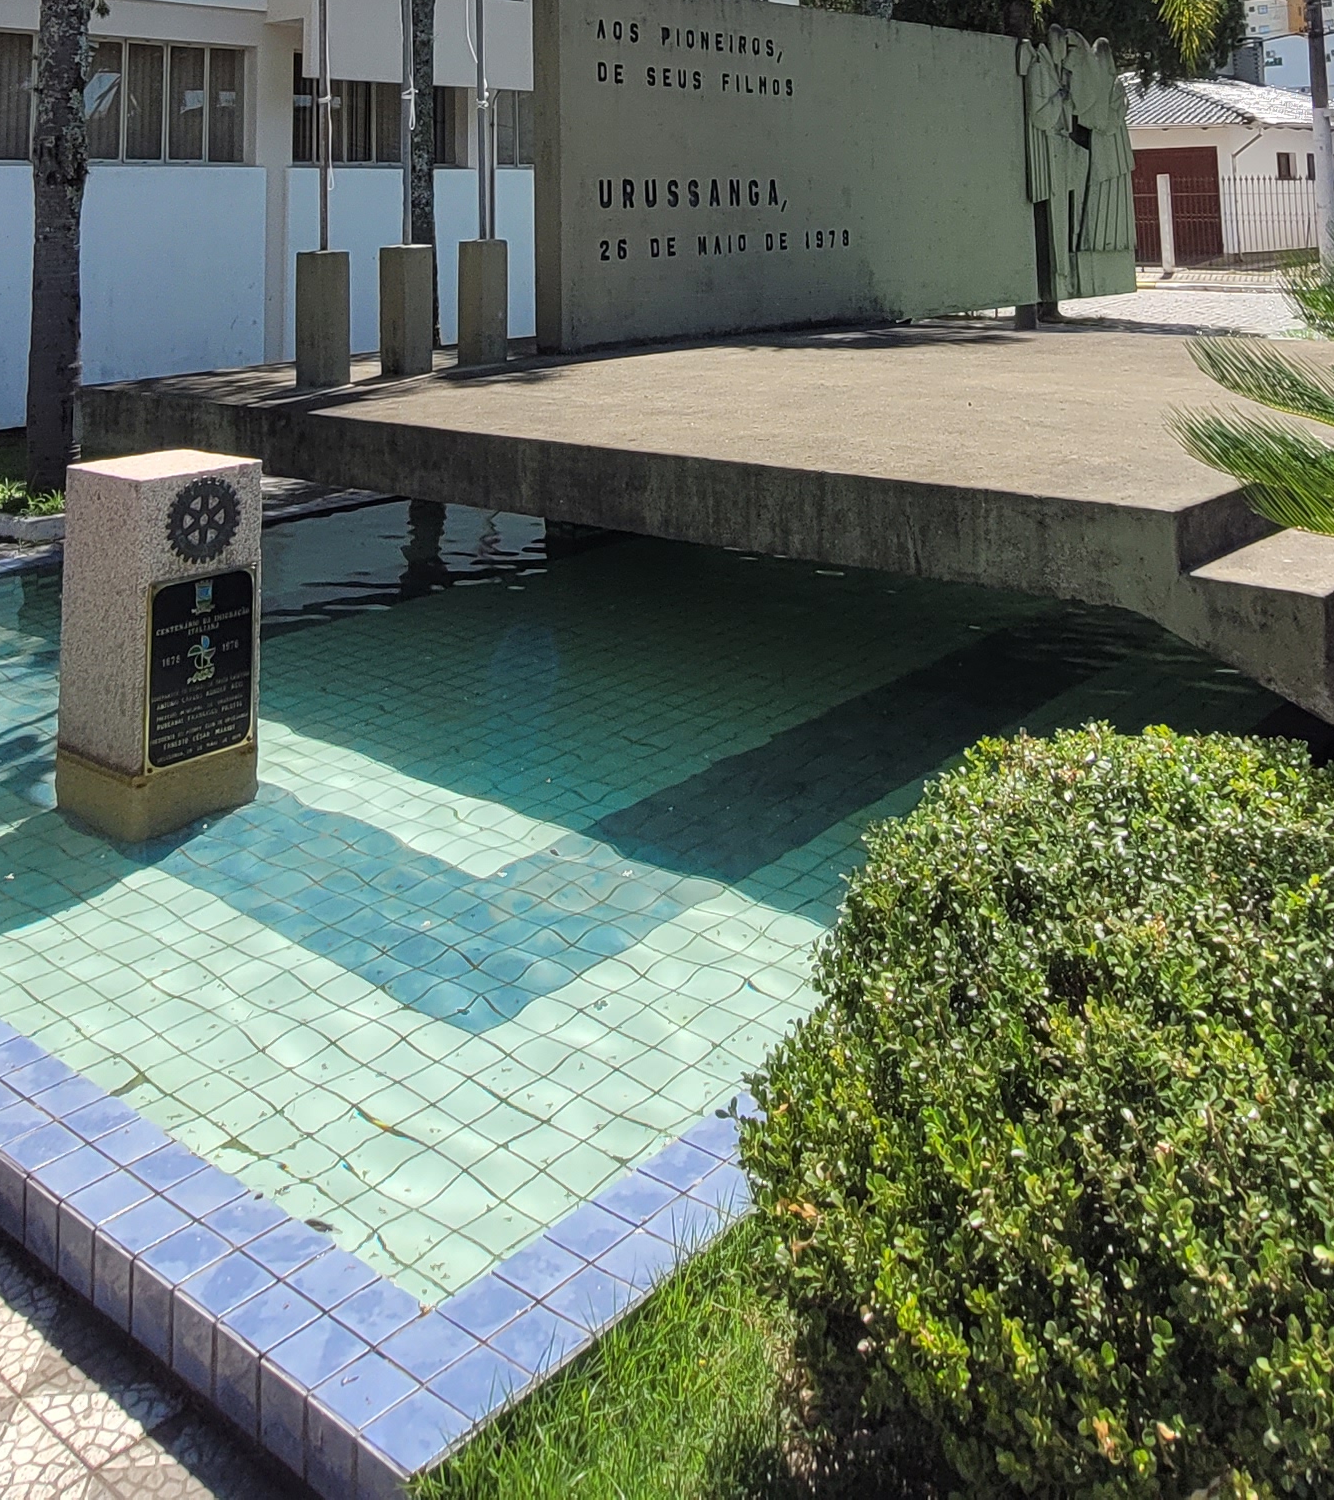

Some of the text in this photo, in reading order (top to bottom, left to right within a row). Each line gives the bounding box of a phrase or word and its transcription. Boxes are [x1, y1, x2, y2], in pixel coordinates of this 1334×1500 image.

[596, 18, 783, 63] AOS PIONEIROS,
[597, 61, 794, 97] DE SEUS FILHOS
[598, 178, 787, 213] URUSSANGA,
[599, 229, 850, 261] 26 DE MAIO DE 1978
